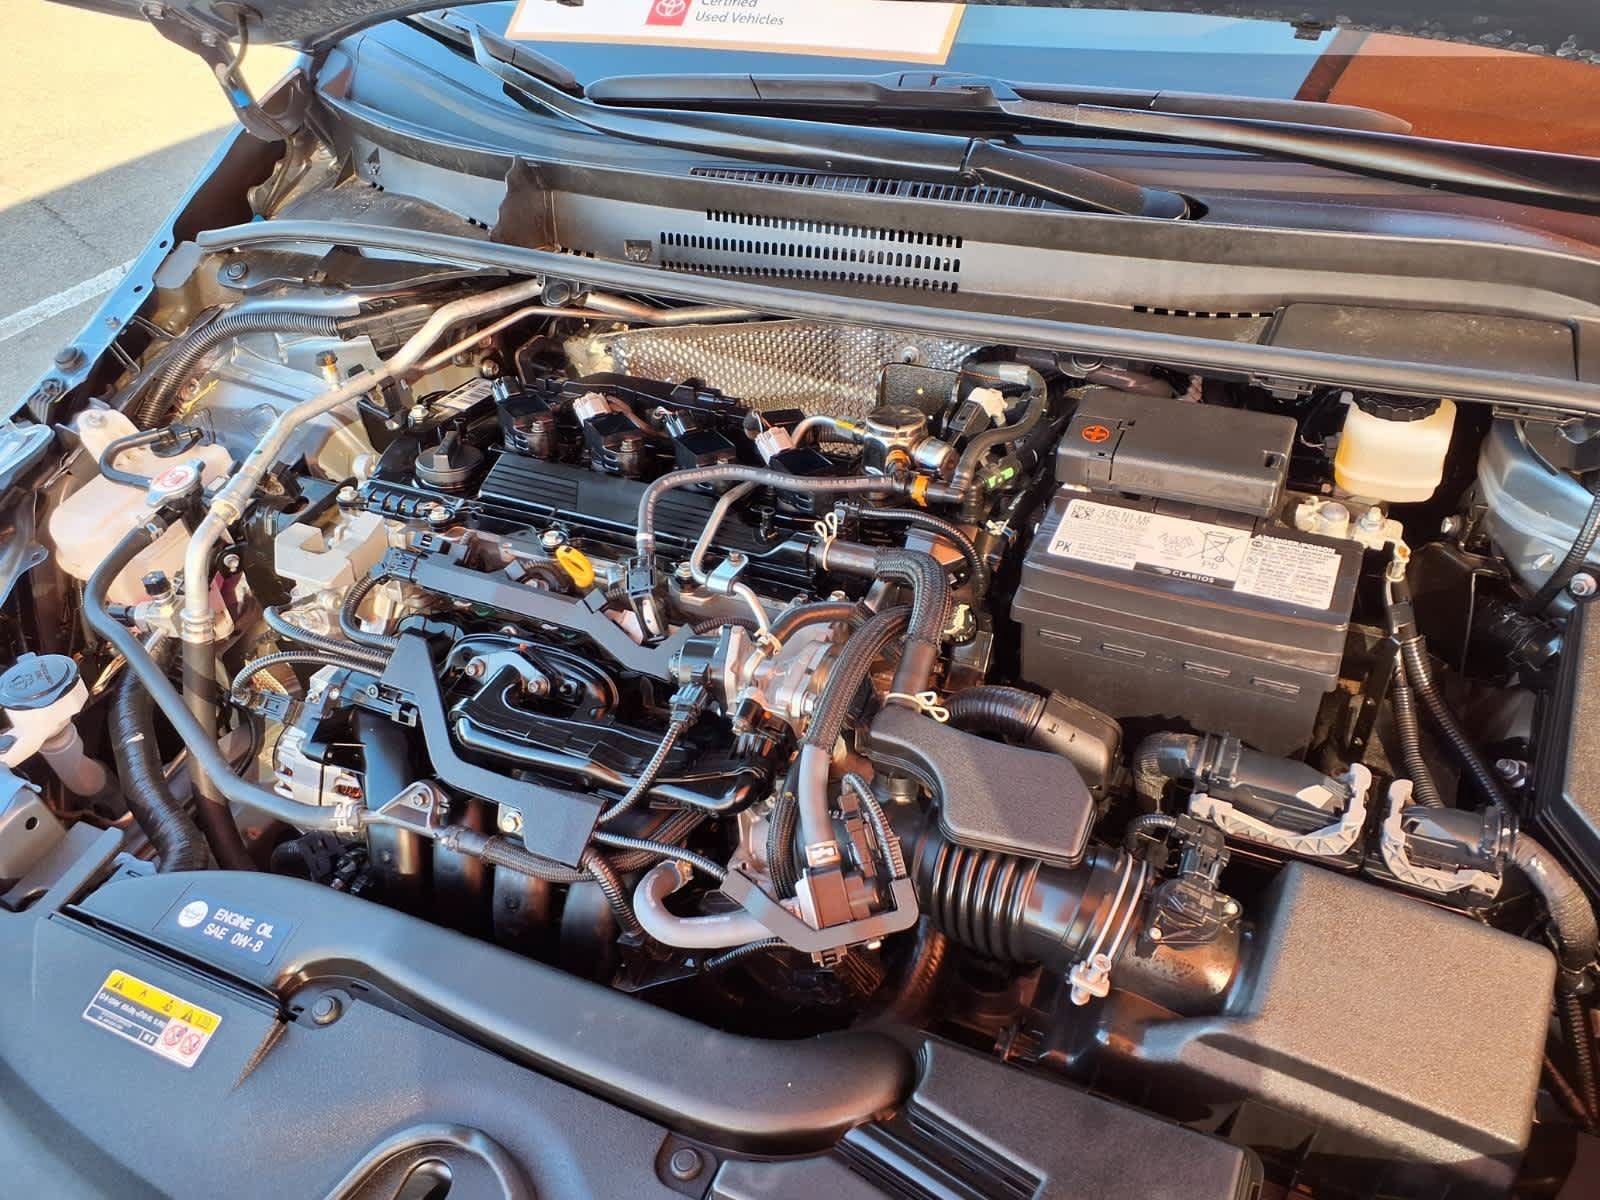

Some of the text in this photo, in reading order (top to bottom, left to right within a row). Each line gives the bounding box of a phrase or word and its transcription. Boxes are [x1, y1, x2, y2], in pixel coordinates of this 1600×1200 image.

[695, 11, 784, 25] Used Vehicles
[1055, 540, 1072, 553] PK
[1172, 570, 1215, 584] CLARIOS
[213, 908, 255, 931] ENGINE
[256, 922, 274, 939] OIL
[203, 923, 229, 940] SAE
